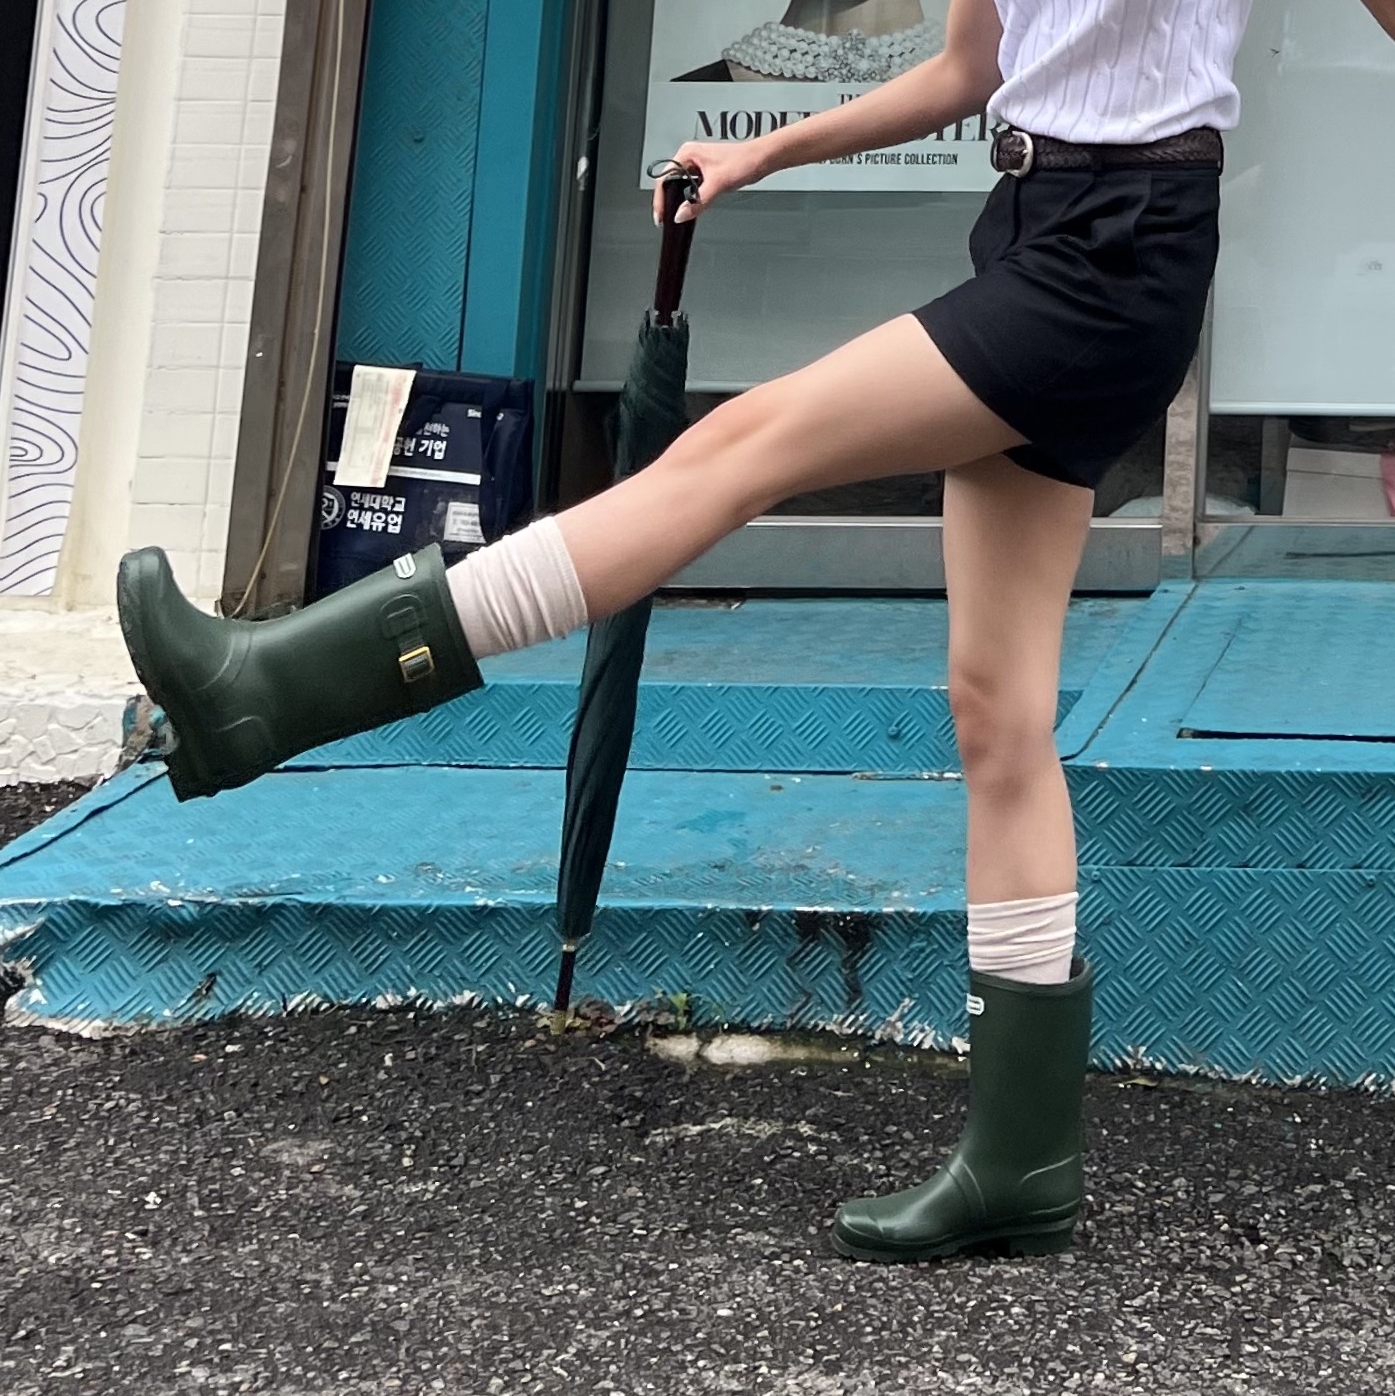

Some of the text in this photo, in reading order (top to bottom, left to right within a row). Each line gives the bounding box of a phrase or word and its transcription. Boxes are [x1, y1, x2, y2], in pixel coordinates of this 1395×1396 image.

[865, 153, 901, 165] PICTURE
[904, 153, 958, 165] COLLECTION
[418, 440, 447, 460] 기업
[351, 492, 406, 512] 연세대학교
[346, 509, 403, 534] 연세유업
